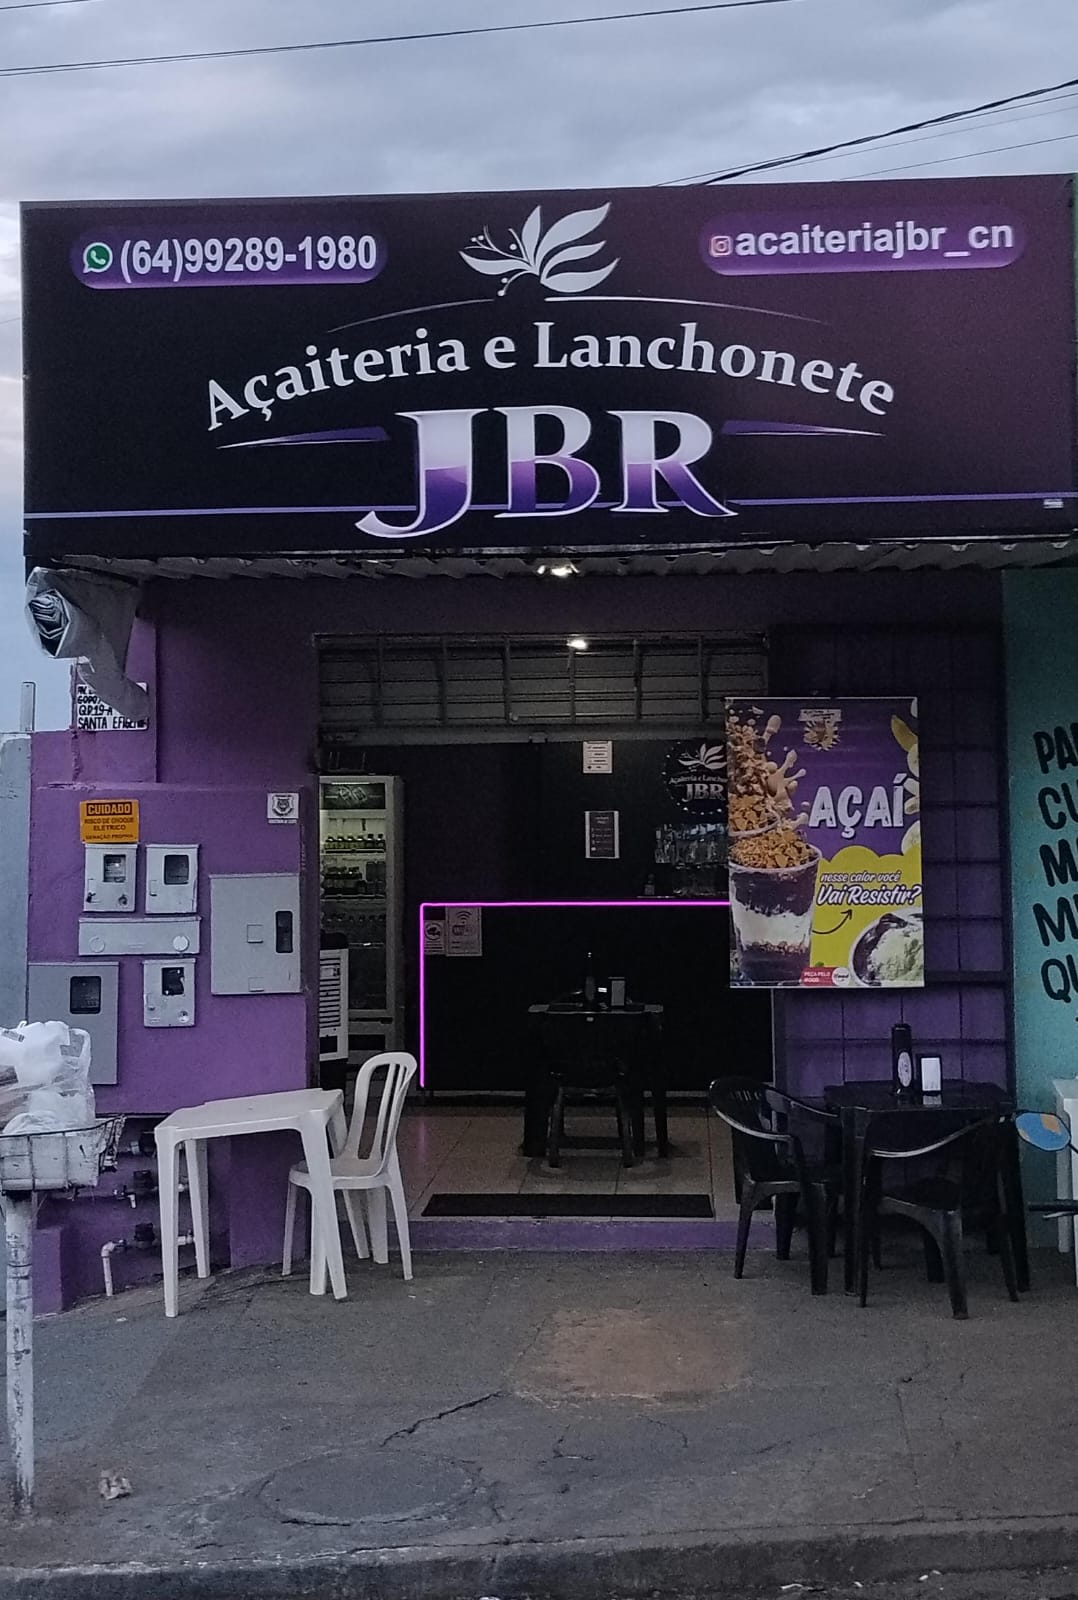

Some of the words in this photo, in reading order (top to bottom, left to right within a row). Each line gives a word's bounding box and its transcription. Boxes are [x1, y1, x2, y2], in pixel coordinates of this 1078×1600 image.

[120, 234, 377, 283] (64)99289-1980
[735, 221, 1014, 259] acaiteriajbr_cn
[206, 327, 471, 432] Açaiteria
[484, 334, 516, 369] e
[534, 321, 895, 416] Lanchonete
[354, 405, 739, 539] JBR
[78, 717, 107, 729] SANTA
[1033, 722, 1078, 774] PA
[87, 803, 131, 815] CUIDADO
[682, 783, 726, 802] JBR
[808, 773, 907, 839] AÇAÍ
[817, 885, 847, 906] Vai
[847, 885, 922, 906] Resistir?
[820, 872, 849, 883] nesse
[849, 870, 876, 883] calor
